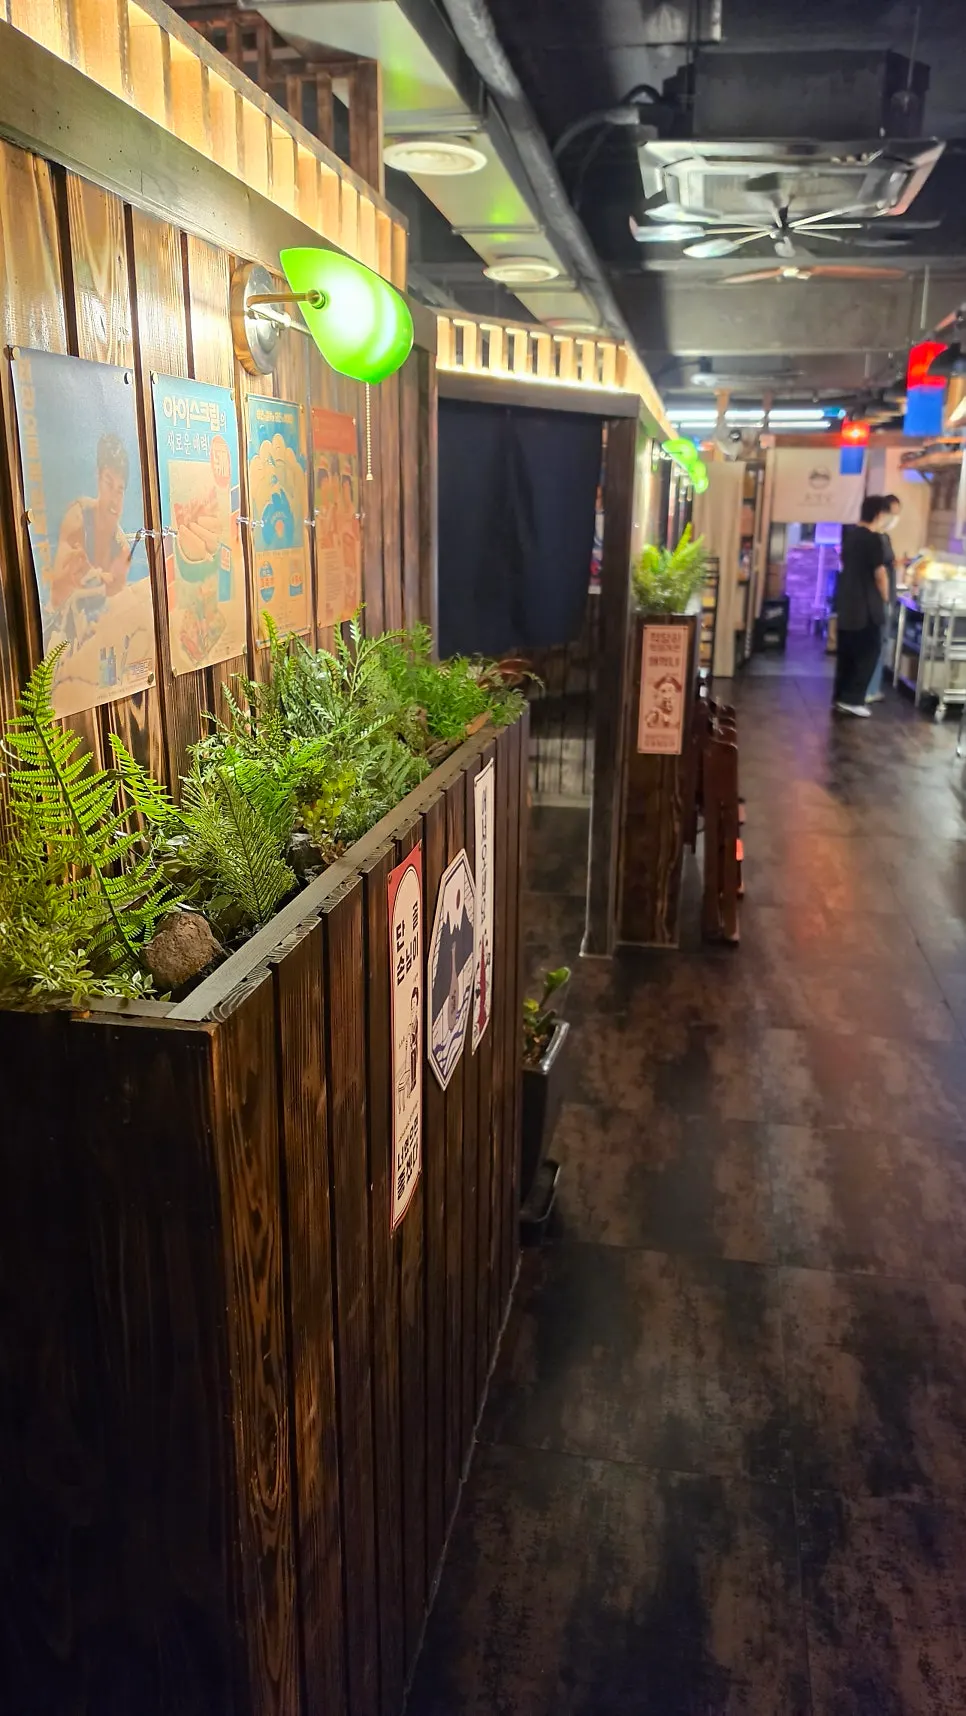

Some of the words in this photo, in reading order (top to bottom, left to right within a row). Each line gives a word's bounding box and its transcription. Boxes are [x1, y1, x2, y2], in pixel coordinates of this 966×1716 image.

[163, 395, 227, 432] 아이스크림의
[167, 430, 192, 455] 새로운
[396, 932, 419, 986] 손님이
